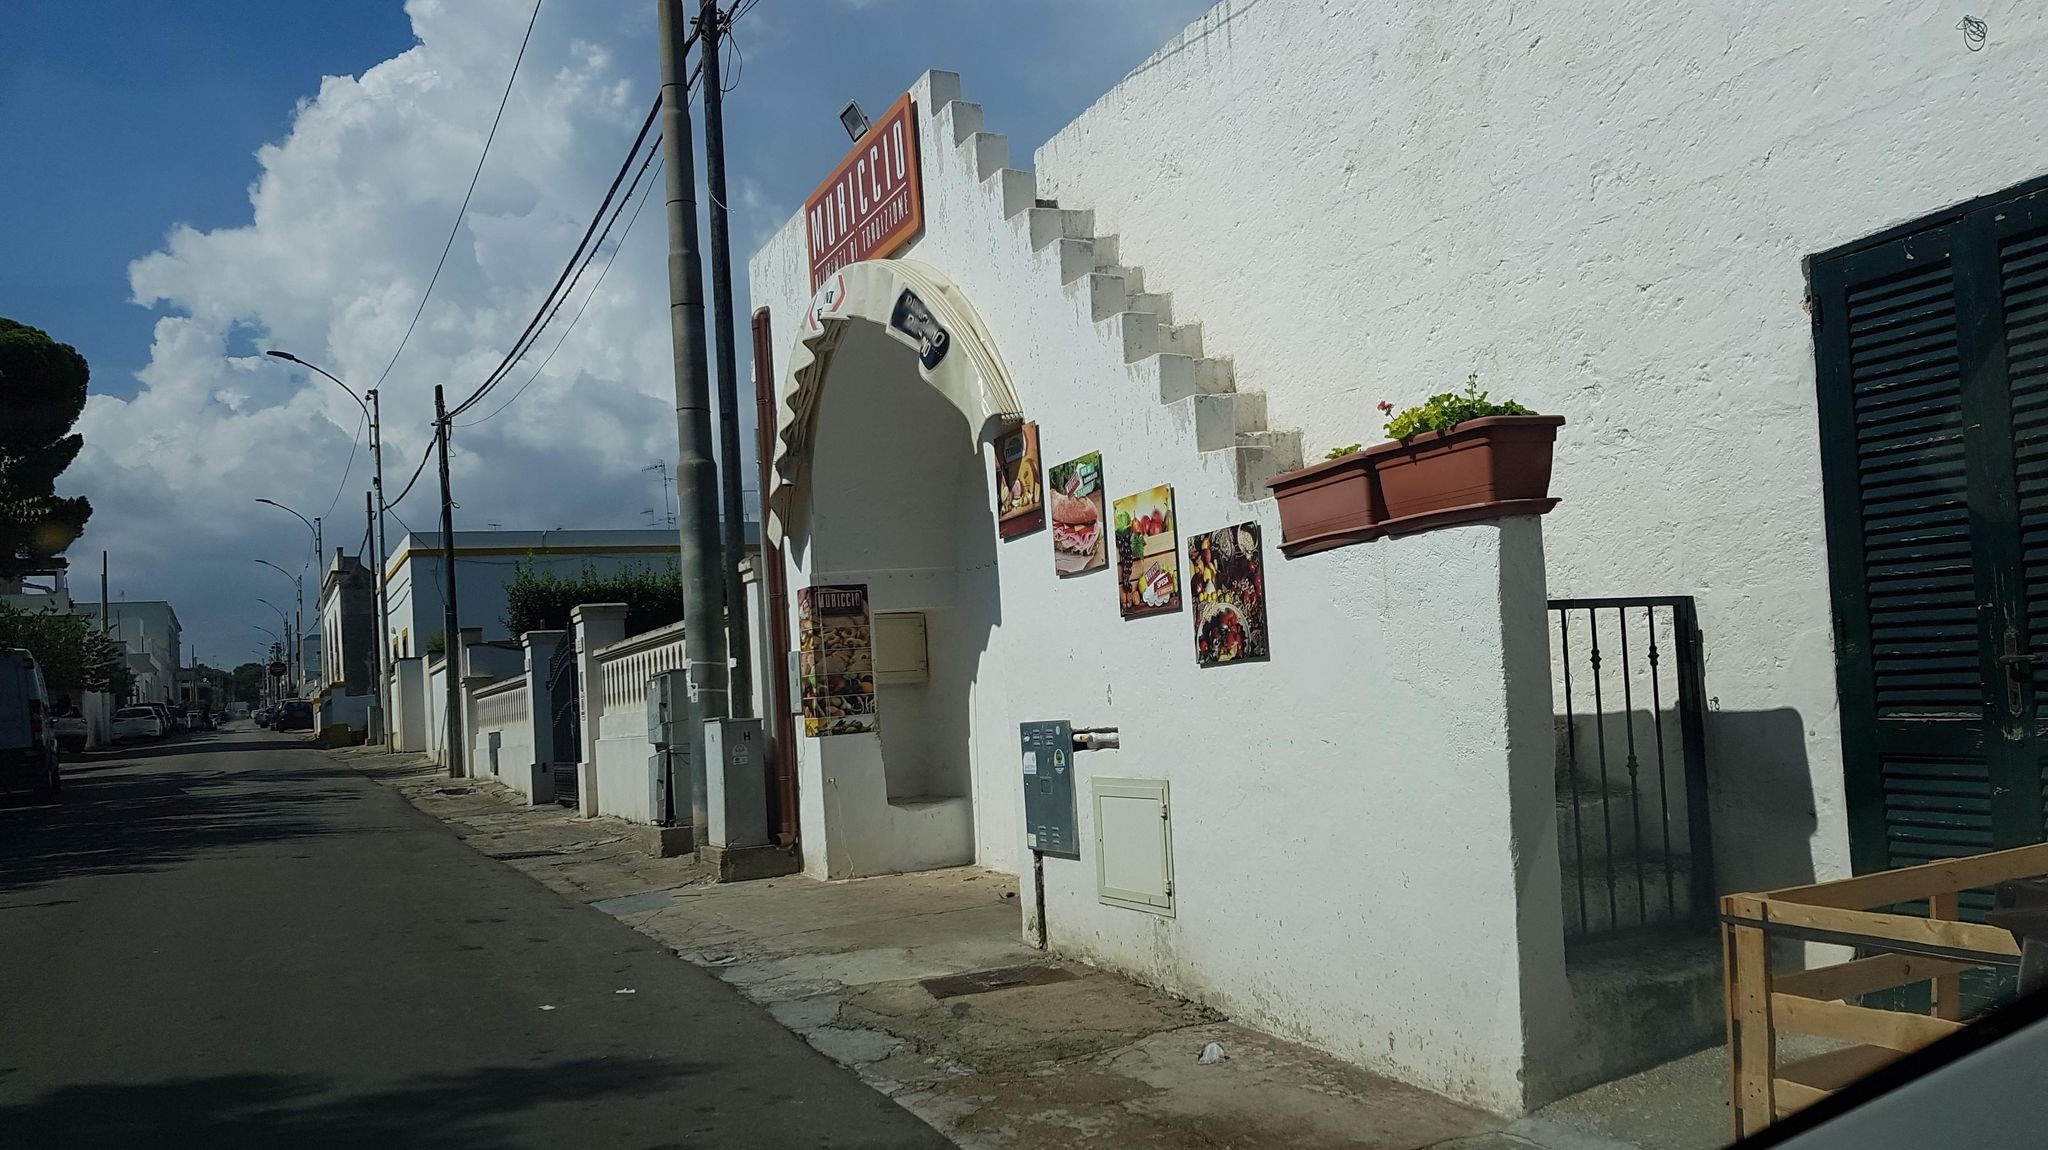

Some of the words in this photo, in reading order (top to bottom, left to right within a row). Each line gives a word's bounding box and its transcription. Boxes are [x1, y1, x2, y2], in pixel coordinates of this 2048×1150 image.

[810, 119, 906, 261] MURICCIO
[862, 190, 909, 252] TRADIZIONE
[817, 592, 861, 608] MURICCIO
